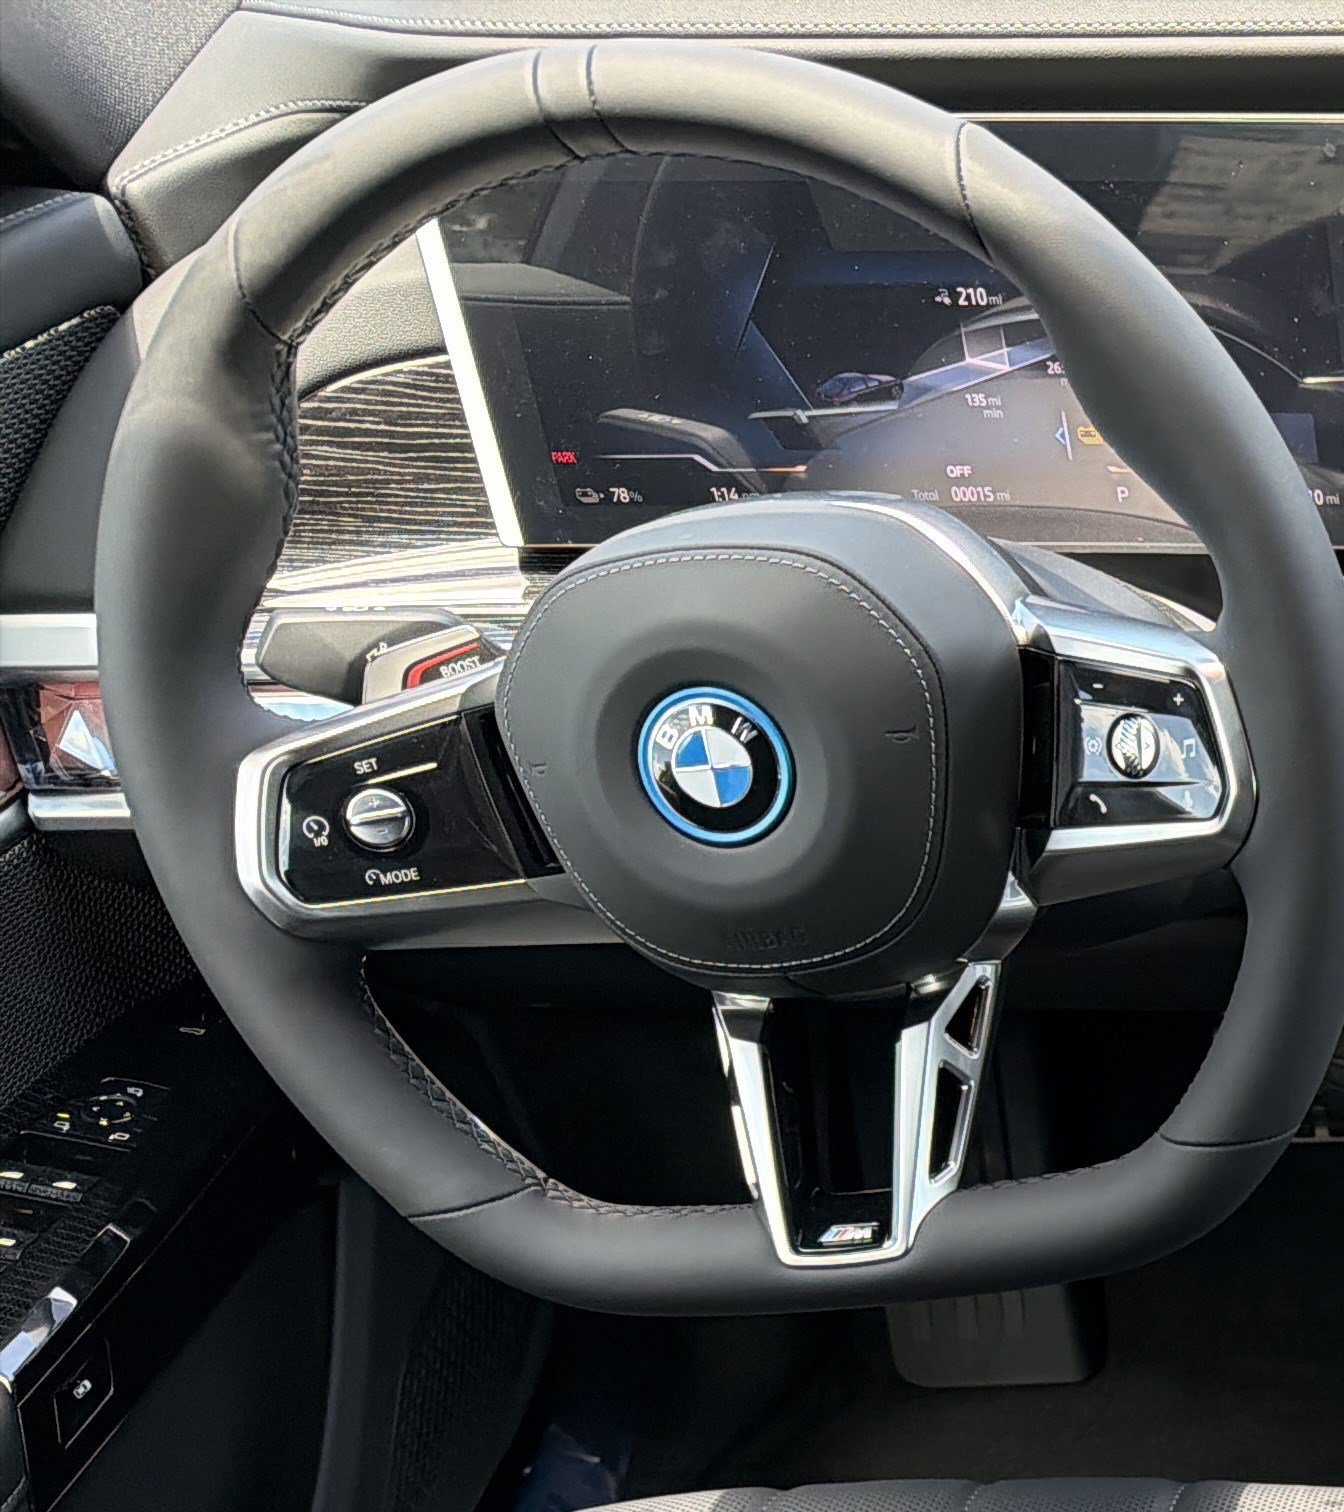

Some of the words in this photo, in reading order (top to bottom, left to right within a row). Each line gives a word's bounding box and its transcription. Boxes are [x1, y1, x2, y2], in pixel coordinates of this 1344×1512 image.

[956, 287, 987, 306] 210
[964, 392, 987, 407] 135
[983, 408, 1004, 419] min
[551, 450, 579, 465] PARK
[946, 465, 972, 478] OFF
[911, 489, 939, 502] Total
[950, 486, 994, 503] 00015
[1117, 486, 1130, 503] P
[439, 656, 481, 679] BOOST
[655, 704, 759, 750] BMW
[353, 757, 379, 776] SET
[379, 867, 421, 886] MODE
